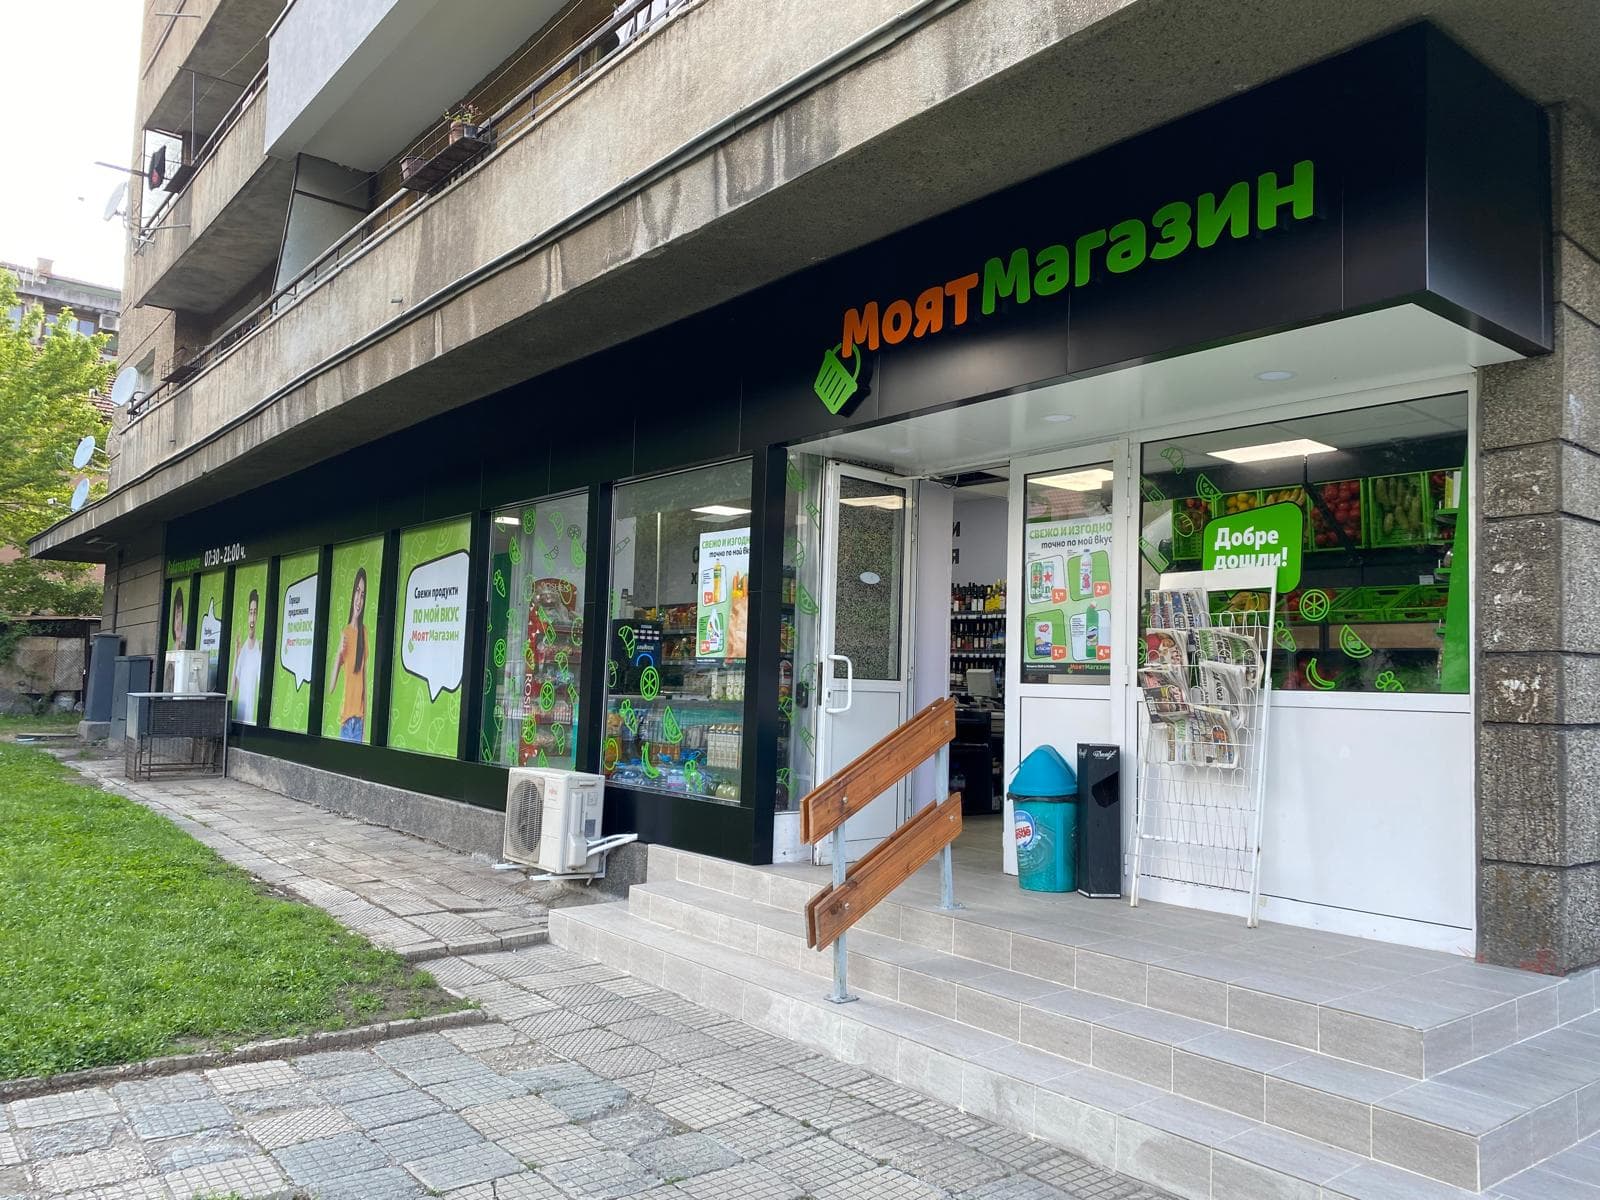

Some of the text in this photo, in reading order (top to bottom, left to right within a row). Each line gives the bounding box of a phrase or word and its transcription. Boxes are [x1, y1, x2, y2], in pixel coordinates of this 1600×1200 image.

[840, 159, 1316, 359] МоятМагазин
[1029, 522, 1112, 540] СВЕЖО И ИЗГОДНО
[1214, 526, 1279, 550] Добре
[701, 539, 722, 549] СВЕЖО
[727, 536, 750, 547] ИЗГОДН
[1041, 540, 1066, 549] точно
[1066, 539, 1077, 547] по
[1077, 536, 1093, 546] мой
[204, 548, 220, 567] 07:30
[223, 542, 240, 563] 21:00
[709, 550, 725, 558] точно
[1214, 546, 1288, 570] дошли!
[414, 586, 459, 601] Свежи продукти
[412, 604, 459, 624] ПО МОЙ ВКУС
[411, 629, 459, 642] МоятМагазин
